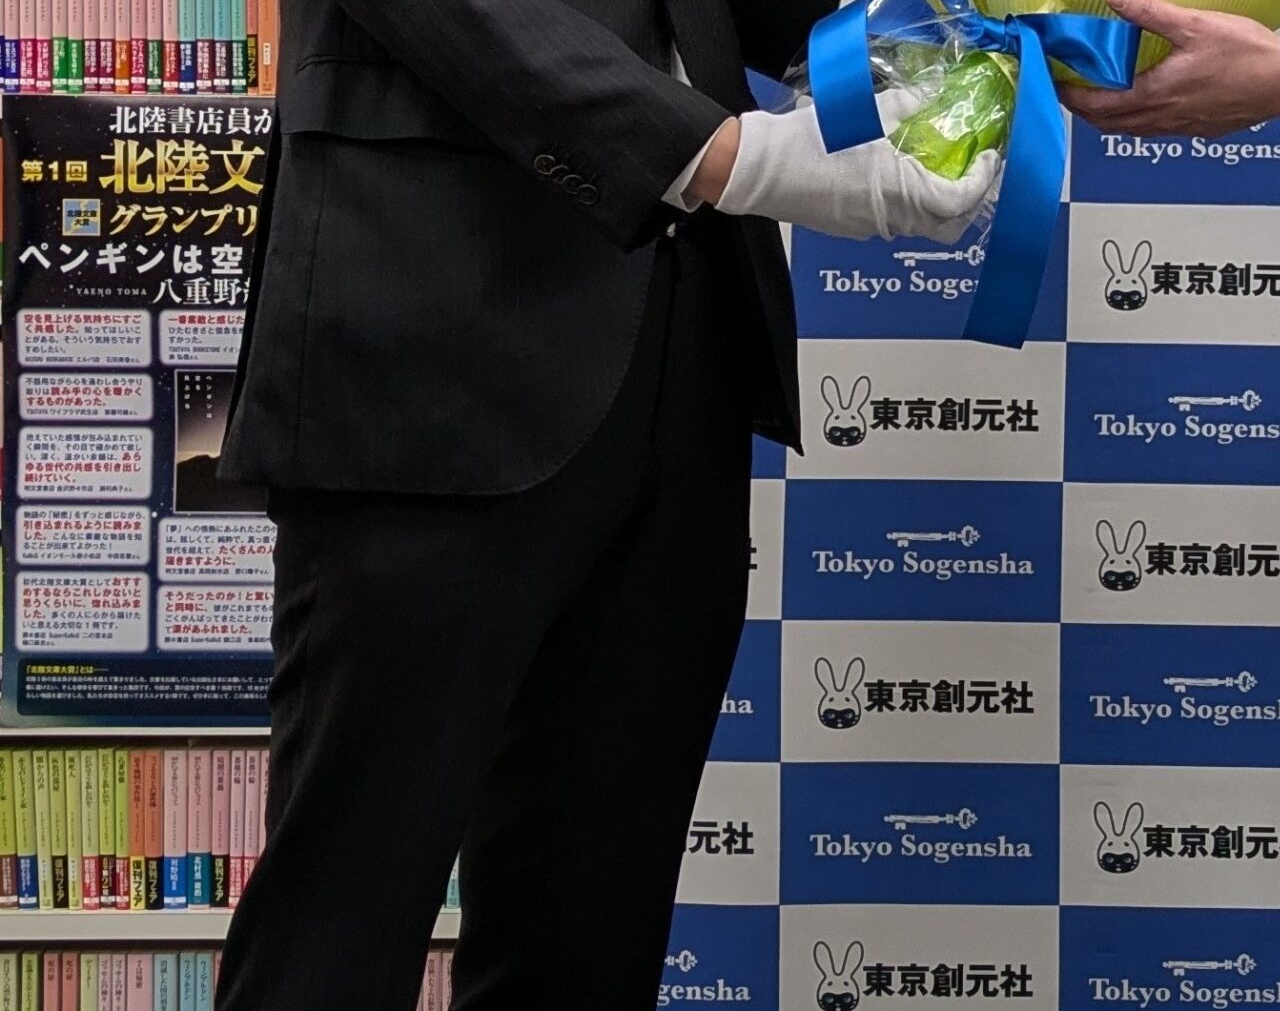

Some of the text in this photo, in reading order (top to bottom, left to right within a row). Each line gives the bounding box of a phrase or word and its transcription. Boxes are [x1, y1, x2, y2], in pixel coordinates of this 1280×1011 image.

[1101, 135, 1182, 163] Tokyo
[21, 160, 88, 182] 第1回
[99, 139, 266, 195] 北陸文
[109, 204, 258, 237] グランプリ
[19, 243, 243, 274] ペンギンは空
[76, 288, 147, 296] YAENO TOMA
[153, 278, 250, 305] 八重野
[820, 270, 978, 299] Tokyo Soge
[24, 314, 141, 323] 空を見上げる気持ちにすご
[26, 397, 106, 406] するものがあった。
[870, 398, 1038, 431] 東京創元社
[1094, 414, 1176, 443] Tokyo
[812, 551, 1034, 580] Tokyo Sogensha
[23, 588, 141, 598] めするならこれしかないと
[864, 680, 1034, 714] 東京創元社
[1090, 696, 1171, 724] Tokyo
[810, 834, 1032, 863] Tokyo Sogensha
[132, 859, 144, 907] 復刊フェア
[658, 979, 750, 1006] gensha
[864, 963, 1033, 997] 東京創元社
[1089, 979, 1170, 1008] Tokyo
